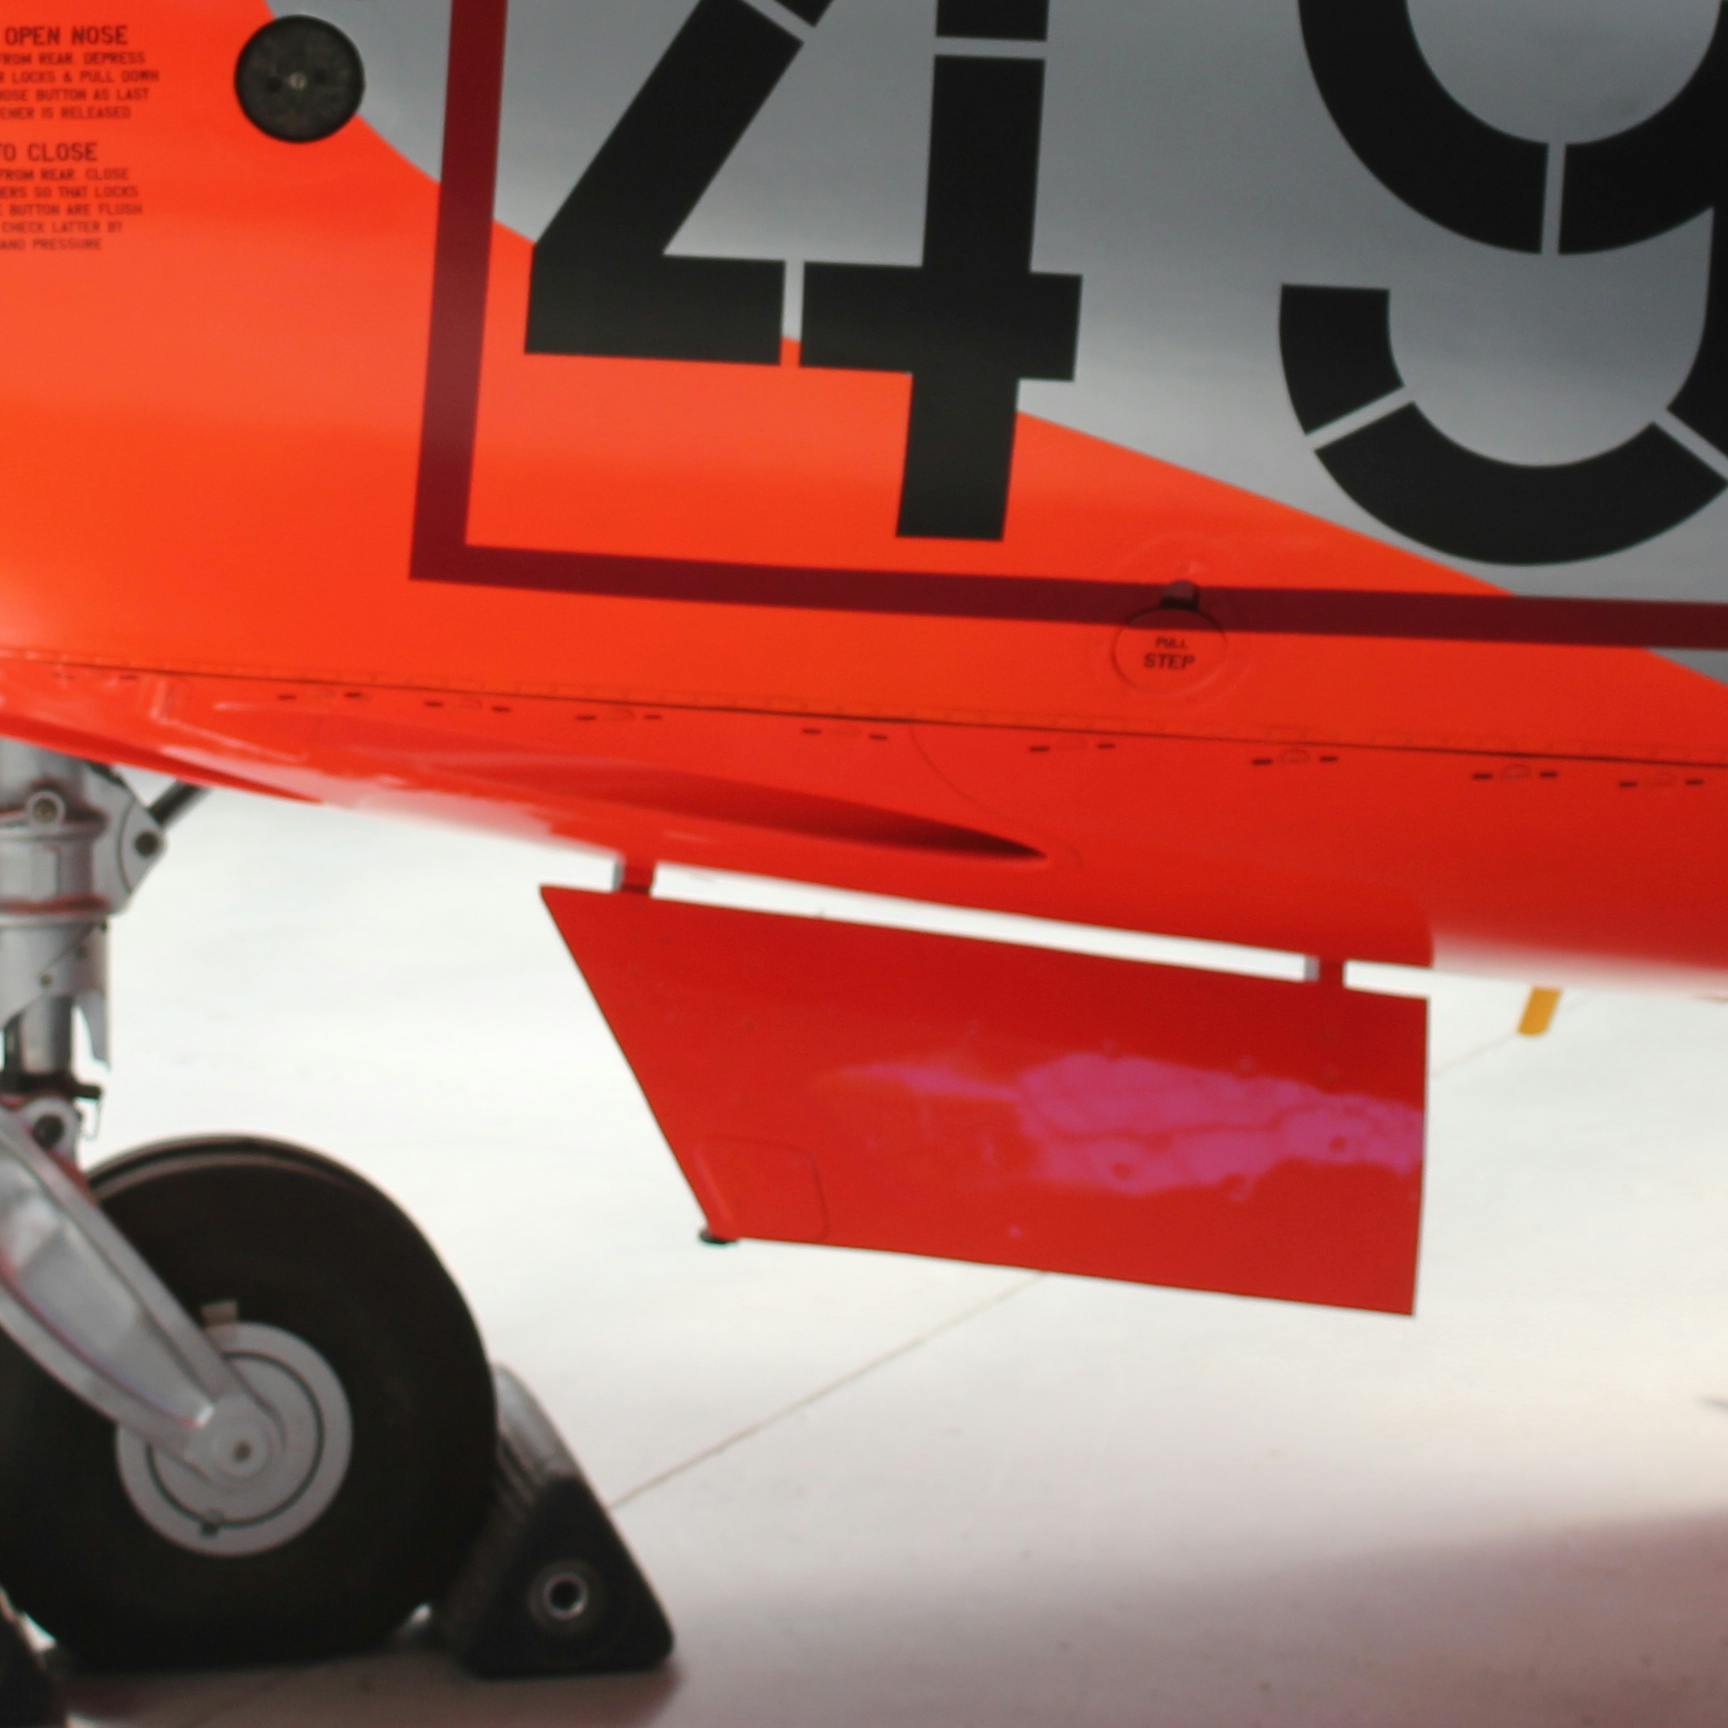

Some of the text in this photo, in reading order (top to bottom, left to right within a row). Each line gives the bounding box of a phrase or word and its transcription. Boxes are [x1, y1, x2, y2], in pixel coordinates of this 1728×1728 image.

[4, 26, 60, 46] OPEN
[70, 25, 128, 46] NOSE
[83, 52, 146, 65] DEPRESS
[12, 71, 56, 83] LOCKS
[63, 71, 73, 83] &
[79, 71, 115, 83] PULL
[121, 71, 160, 83] DOWN
[35, 89, 87, 101] BUTTON
[92, 89, 110, 101] AS
[116, 88, 150, 101] LAST
[40, 107, 54, 119] IS
[59, 106, 131, 119] RELEASED
[27, 142, 98, 162] CLOSE
[85, 168, 129, 180] CLOSE
[33, 186, 53, 198] SO
[59, 186, 88, 198] THAT
[95, 186, 139, 198] LOCKS
[9, 204, 61, 215] BUTTON
[67, 203, 92, 215] ARE
[97, 203, 144, 215] FLUSH
[1, 222, 45, 233] CHECK
[52, 222, 101, 233] LATTER
[107, 221, 123, 232] BY
[31, 238, 102, 250] PRESSURE
[1155, 635, 1187, 649] PULL
[1143, 652, 1196, 670] STEP
